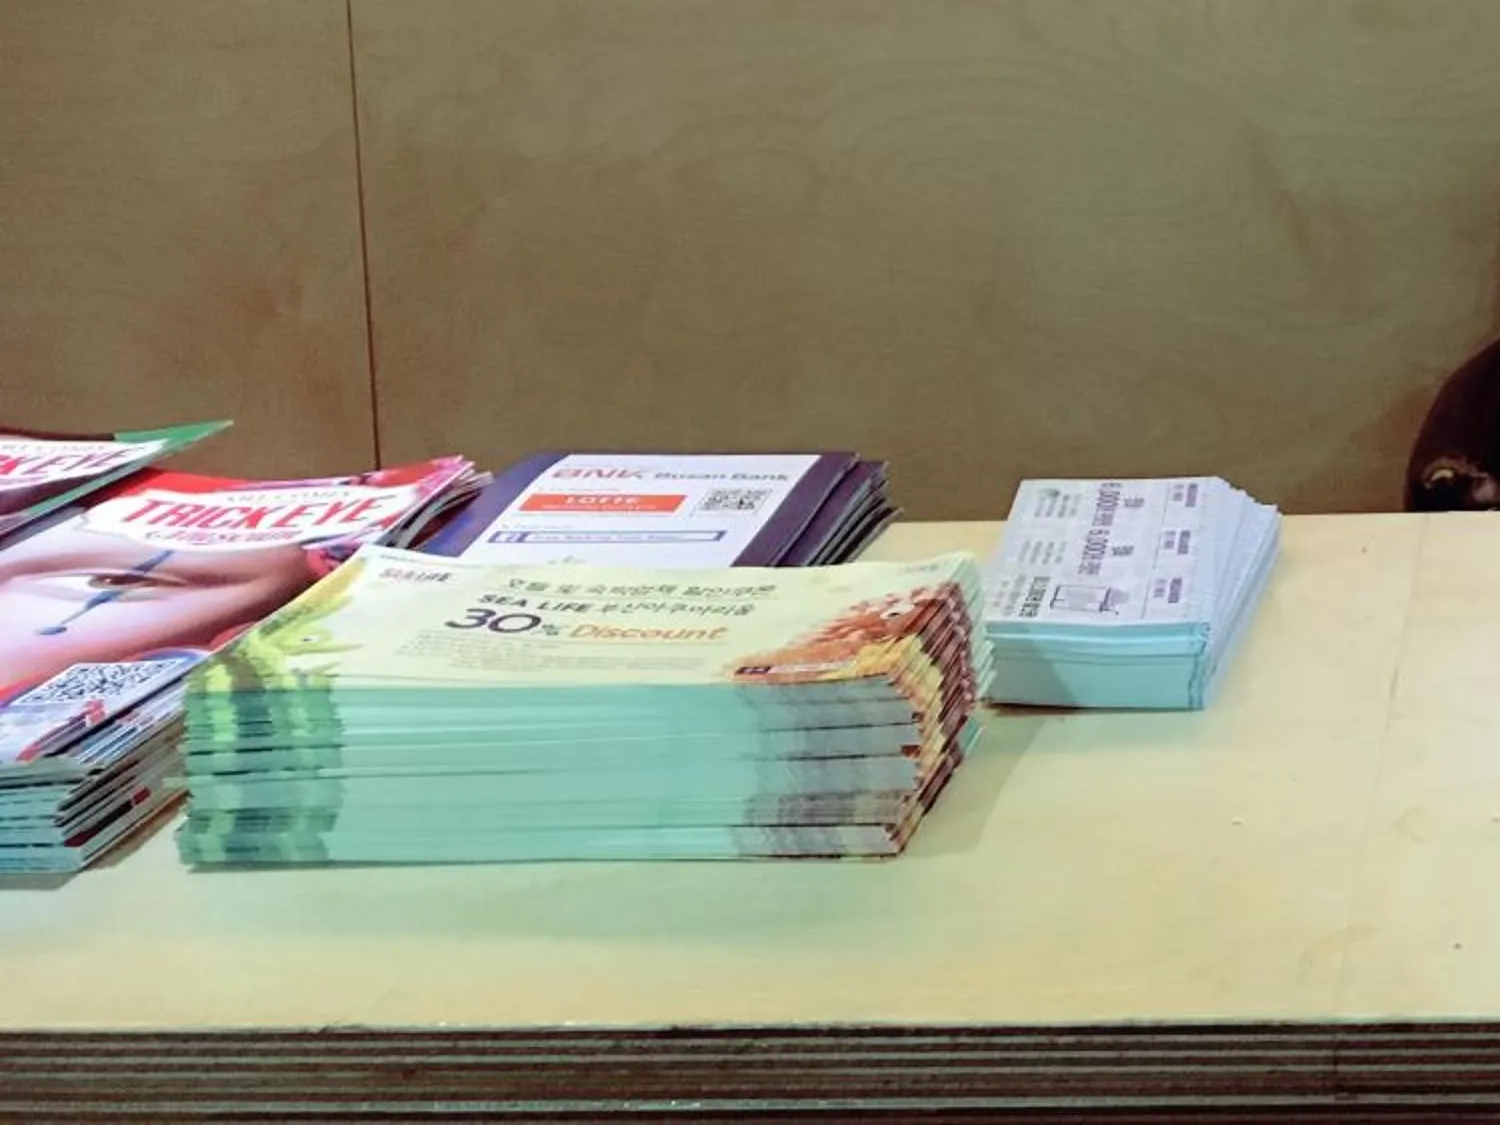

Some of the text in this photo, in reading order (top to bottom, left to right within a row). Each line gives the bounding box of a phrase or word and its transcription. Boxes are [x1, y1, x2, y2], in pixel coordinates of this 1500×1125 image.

[730, 472, 790, 482] Bank
[479, 593, 528, 608] SEA
[536, 601, 595, 614] LIFE
[567, 623, 729, 641] Discount
